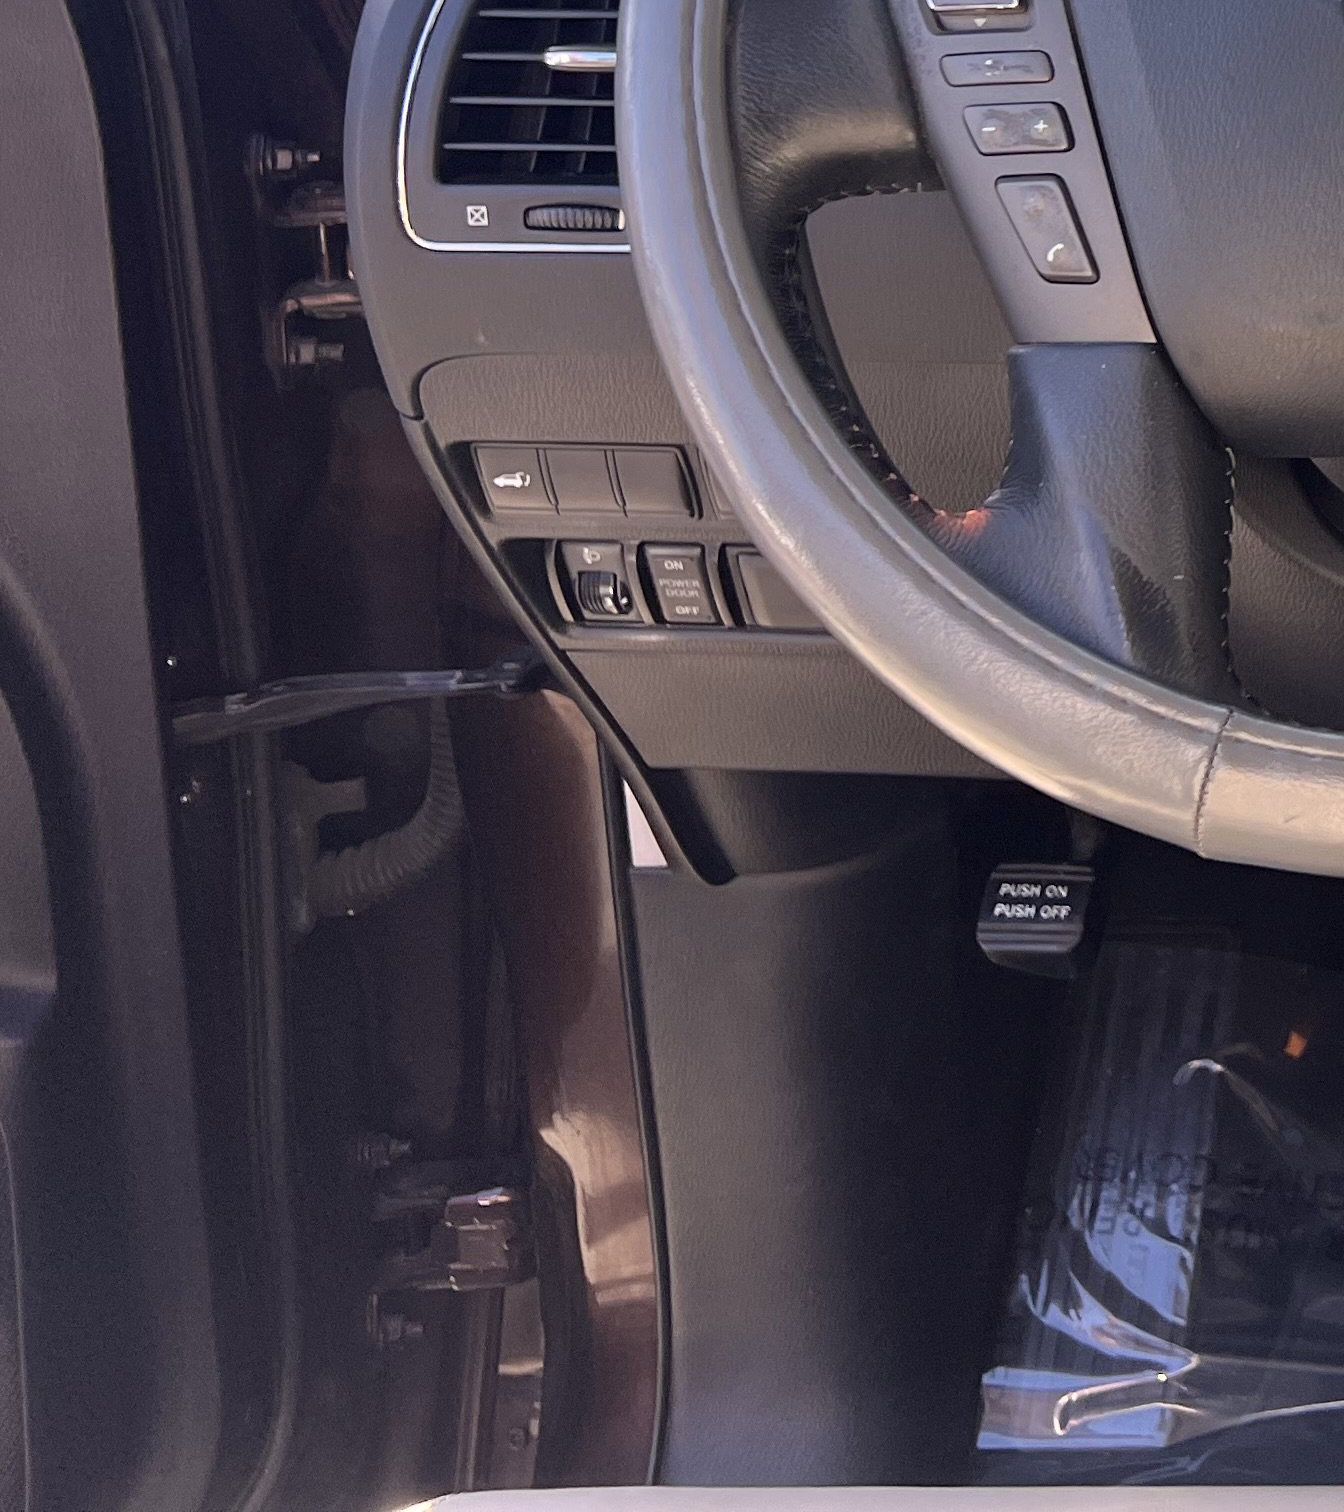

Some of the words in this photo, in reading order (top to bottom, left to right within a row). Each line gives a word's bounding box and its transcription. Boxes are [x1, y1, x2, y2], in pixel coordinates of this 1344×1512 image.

[664, 560, 684, 570] ON
[998, 882, 1042, 899] PUSH
[1045, 885, 1068, 898] ON
[993, 903, 1036, 919] PUSH
[1040, 905, 1071, 920] OFF
